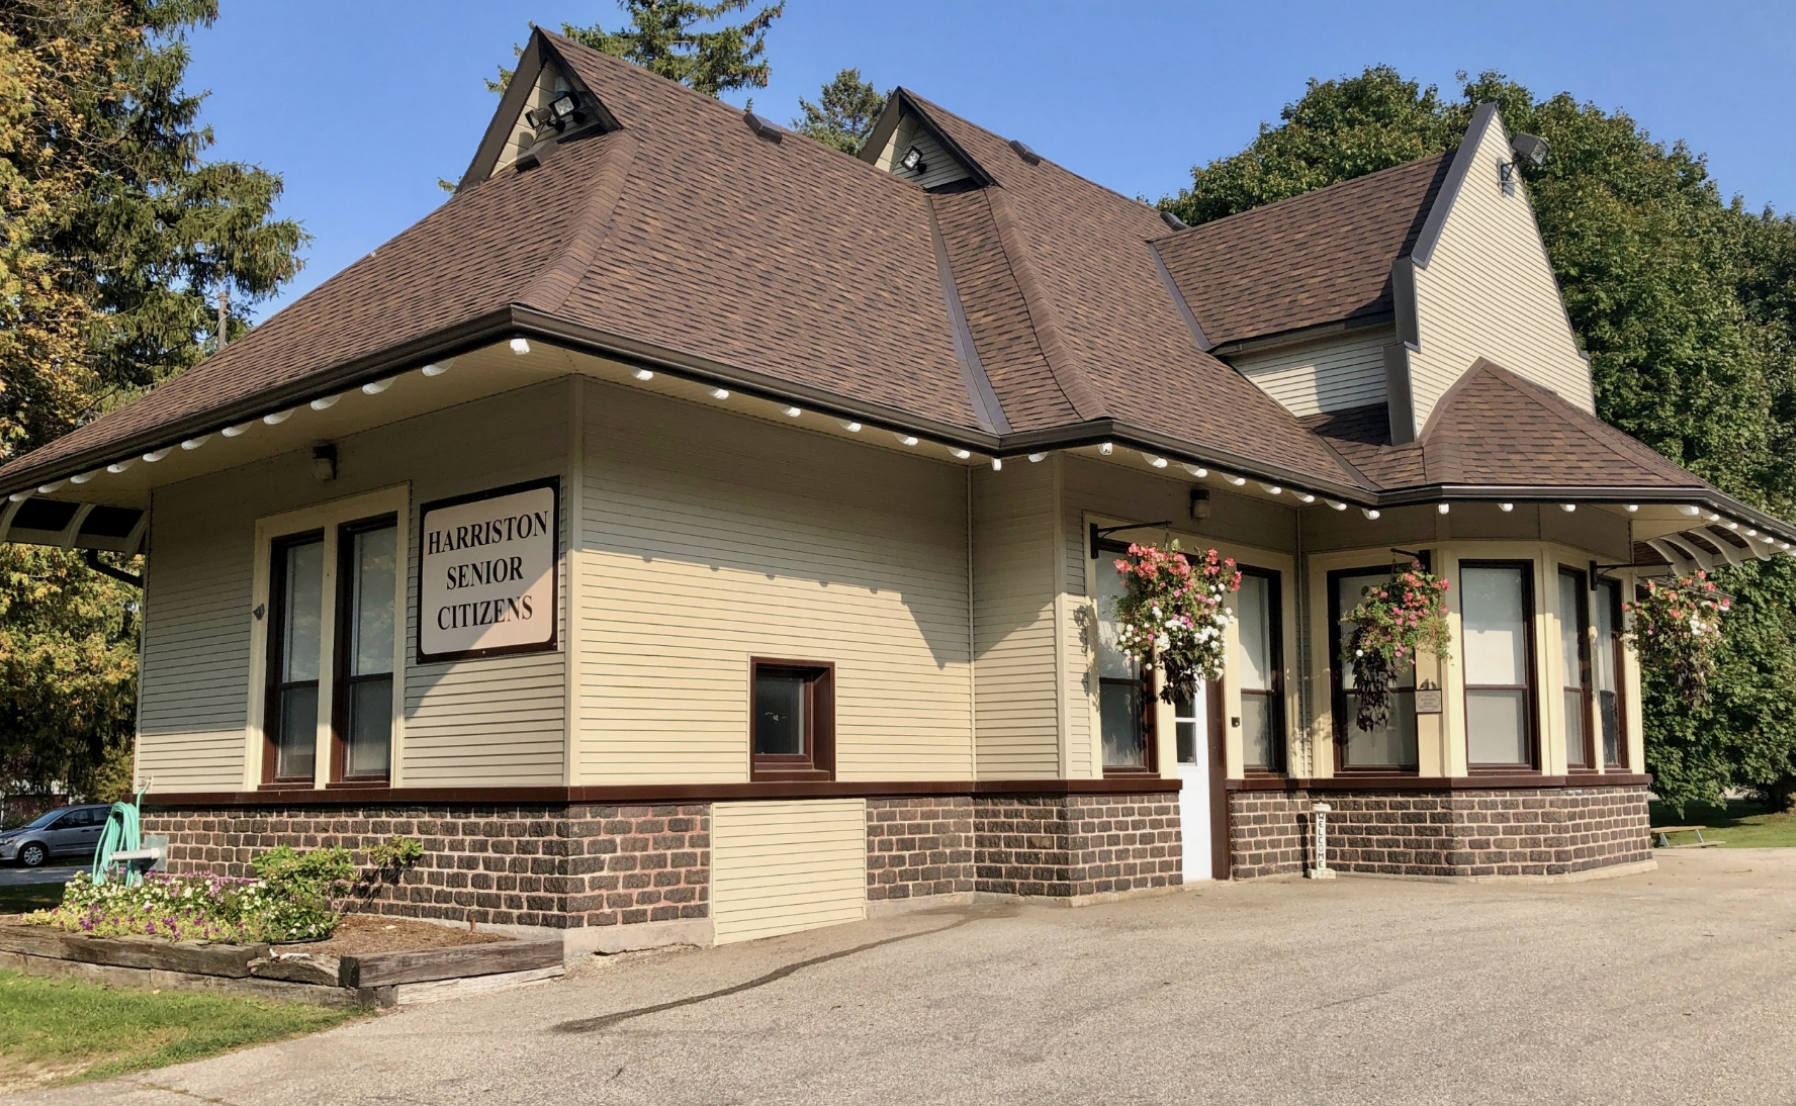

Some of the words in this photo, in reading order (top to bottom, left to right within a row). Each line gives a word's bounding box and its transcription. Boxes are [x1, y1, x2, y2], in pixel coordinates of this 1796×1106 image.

[428, 511, 549, 555] HARRISTON
[447, 556, 524, 591] SENIOR
[437, 595, 533, 630] CITIZENS
